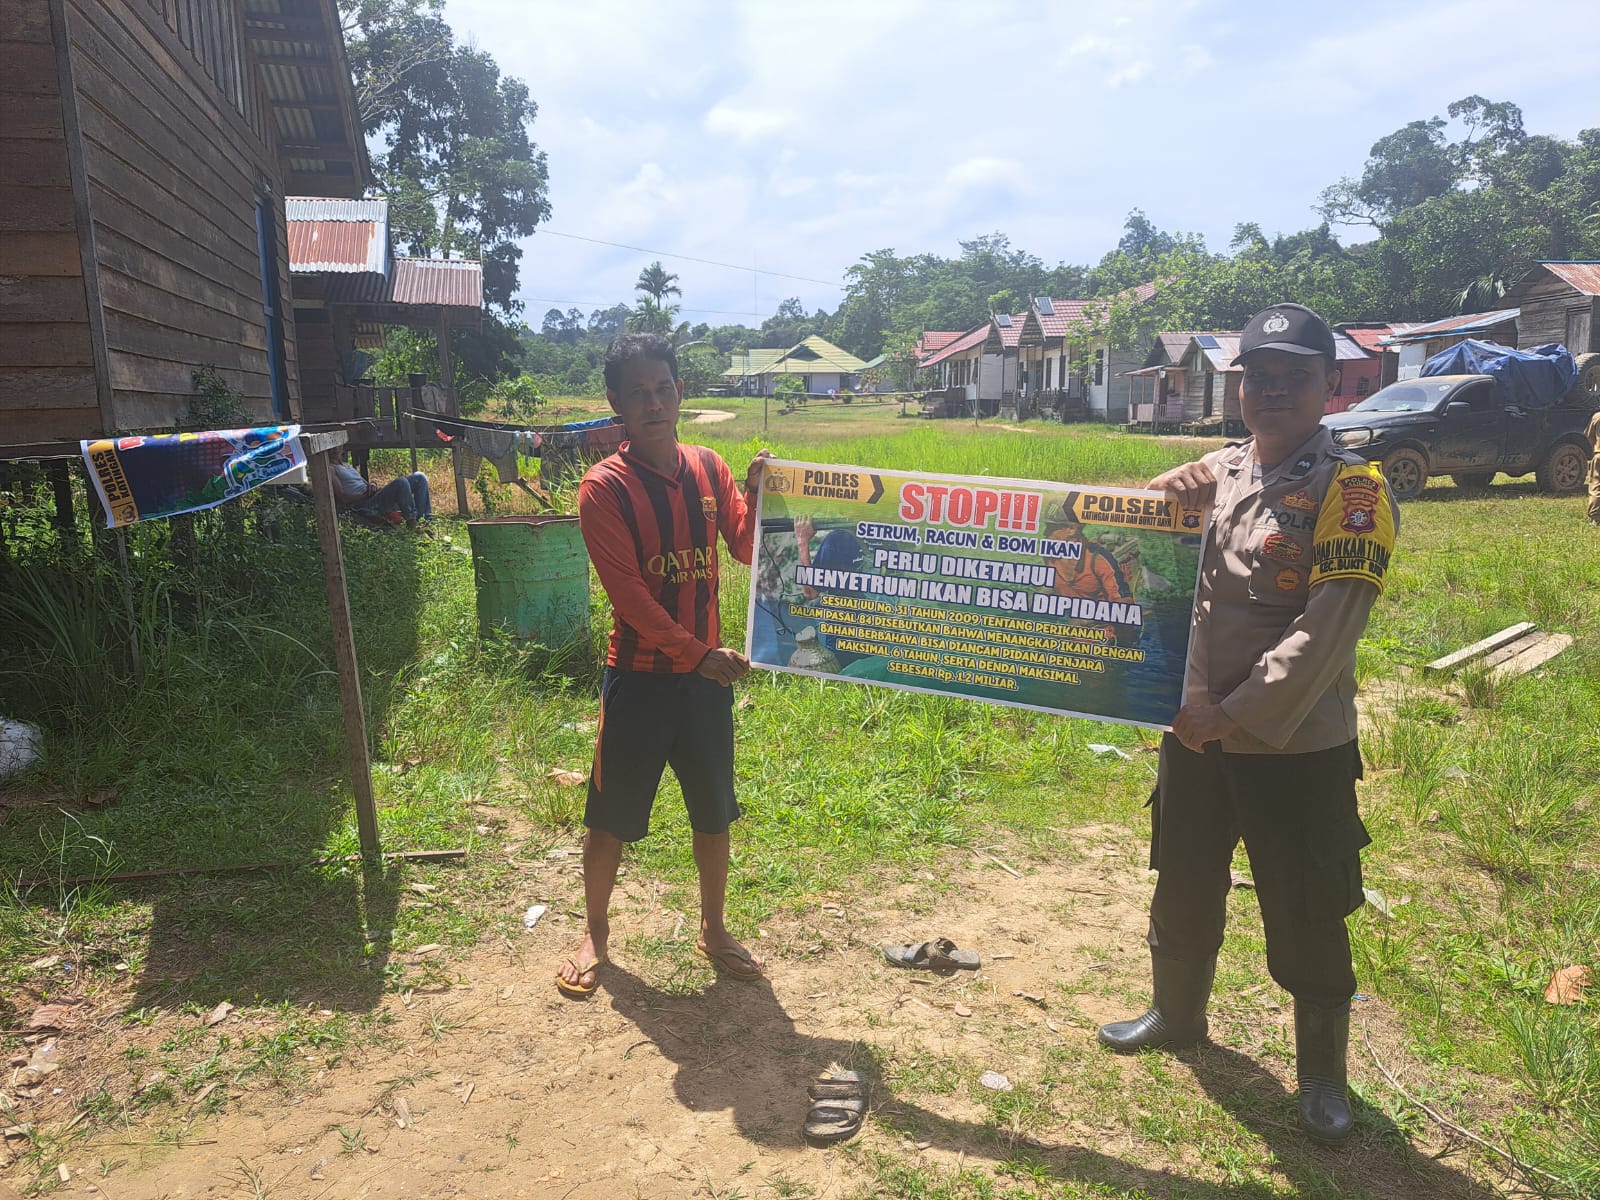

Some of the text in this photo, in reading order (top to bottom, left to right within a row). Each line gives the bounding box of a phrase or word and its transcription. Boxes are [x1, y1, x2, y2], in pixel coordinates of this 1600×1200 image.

[92, 452, 121, 502] POLRES
[104, 450, 130, 498] KATINGAN
[803, 486, 859, 500] KATINGAN
[804, 469, 859, 488] POLRES
[901, 483, 1040, 530] STOP!!!
[1081, 512, 1109, 522] KATINGAN
[1110, 513, 1125, 523] HULU
[1126, 515, 1138, 524] DAN
[1139, 516, 1156, 526] BUKIT
[1083, 495, 1172, 517] POLSEK
[1265, 510, 1315, 531] POLR
[857, 523, 1081, 559] SETRUM, RACUN & BOM IKAN
[647, 546, 713, 576] QATAR
[874, 549, 1056, 587] PERLU DIKETAHUI
[796, 566, 1142, 625] MENYETRUM IKAN BISA DIPIDANA
[789, 605, 1145, 662] DALAM PASAL 84 DISEBUTKAN BAHWA MENANGKAP IKAN DENGAN
[822, 595, 1107, 643] SESUAI UU No. 31 TAHUN 2009 TENTANG PERIKANAN,
[820, 623, 1104, 673] BAHAN BERBAHAYA BISA DIANCAM PIDANA PENJARA
[836, 640, 1081, 684] MAKSIMAL 6 TAHUN, SERTA DENDA MAKSIMAL
[888, 662, 936, 678] SEBESAR
[937, 669, 955, 683] Rp.
[974, 676, 1019, 691] MILIAR.
